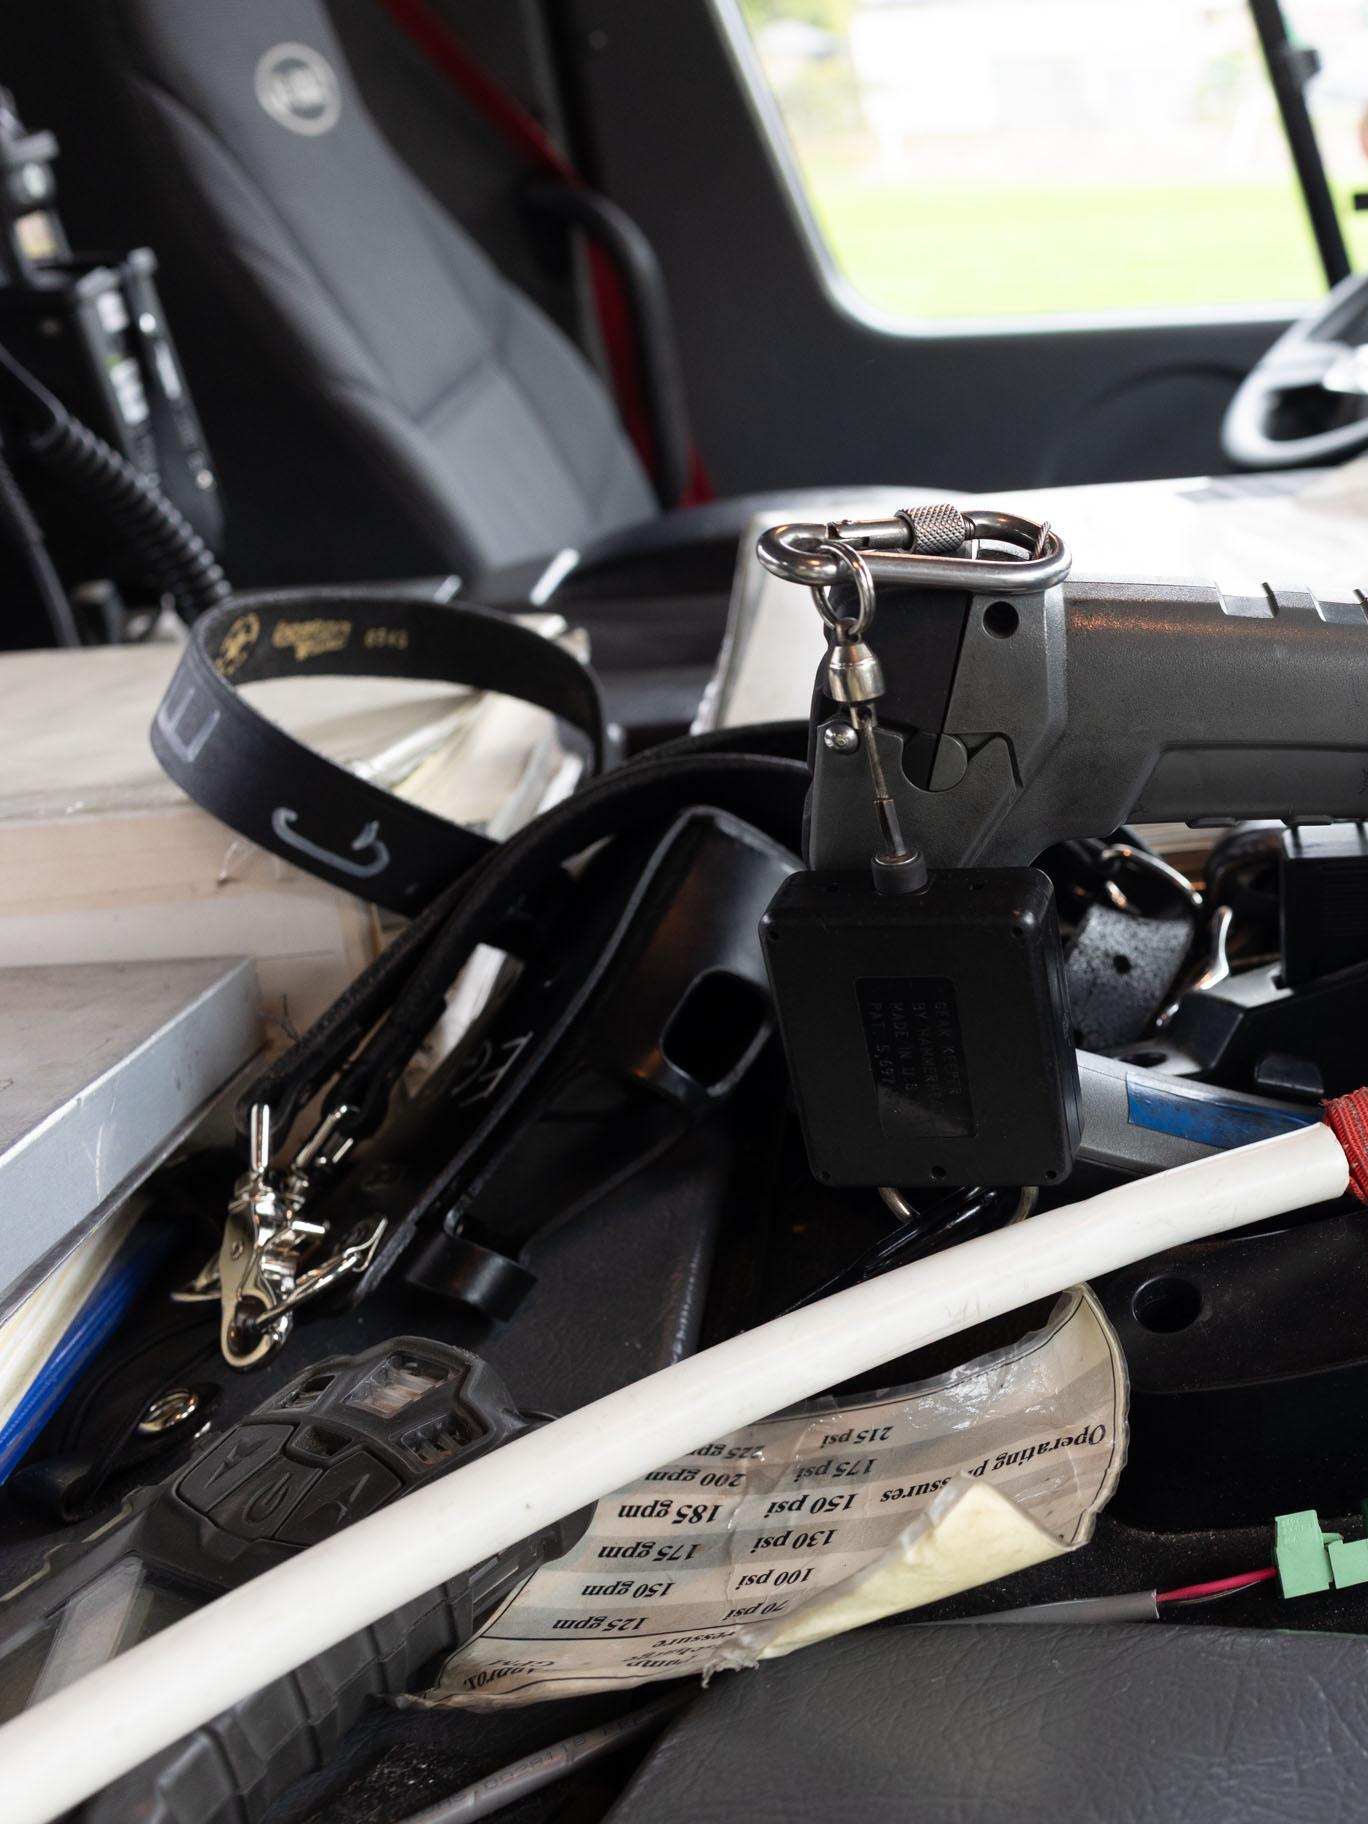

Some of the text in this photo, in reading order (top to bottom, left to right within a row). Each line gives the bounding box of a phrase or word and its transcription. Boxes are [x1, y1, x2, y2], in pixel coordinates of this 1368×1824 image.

[890, 1002, 909, 1039] MADE
[912, 1002, 928, 1019] BY
[898, 1047, 912, 1059] IN
[820, 1425, 894, 1449] 215 psi
[724, 1445, 766, 1459] 225
[992, 1424, 1106, 1471] Operating
[645, 1469, 746, 1487] 200 gpm
[793, 1458, 877, 1483] 175 psi
[618, 1500, 723, 1525] 185 gpm
[764, 1493, 859, 1518] 150 psi
[598, 1541, 702, 1561] 175 gpm
[750, 1529, 838, 1553] 130 psi
[581, 1580, 675, 1598] 150 gpm
[735, 1568, 814, 1590] 100 psi
[722, 1600, 789, 1620] 70 psi
[552, 1616, 649, 1631] 125 gpm
[652, 1632, 736, 1647] ressure
